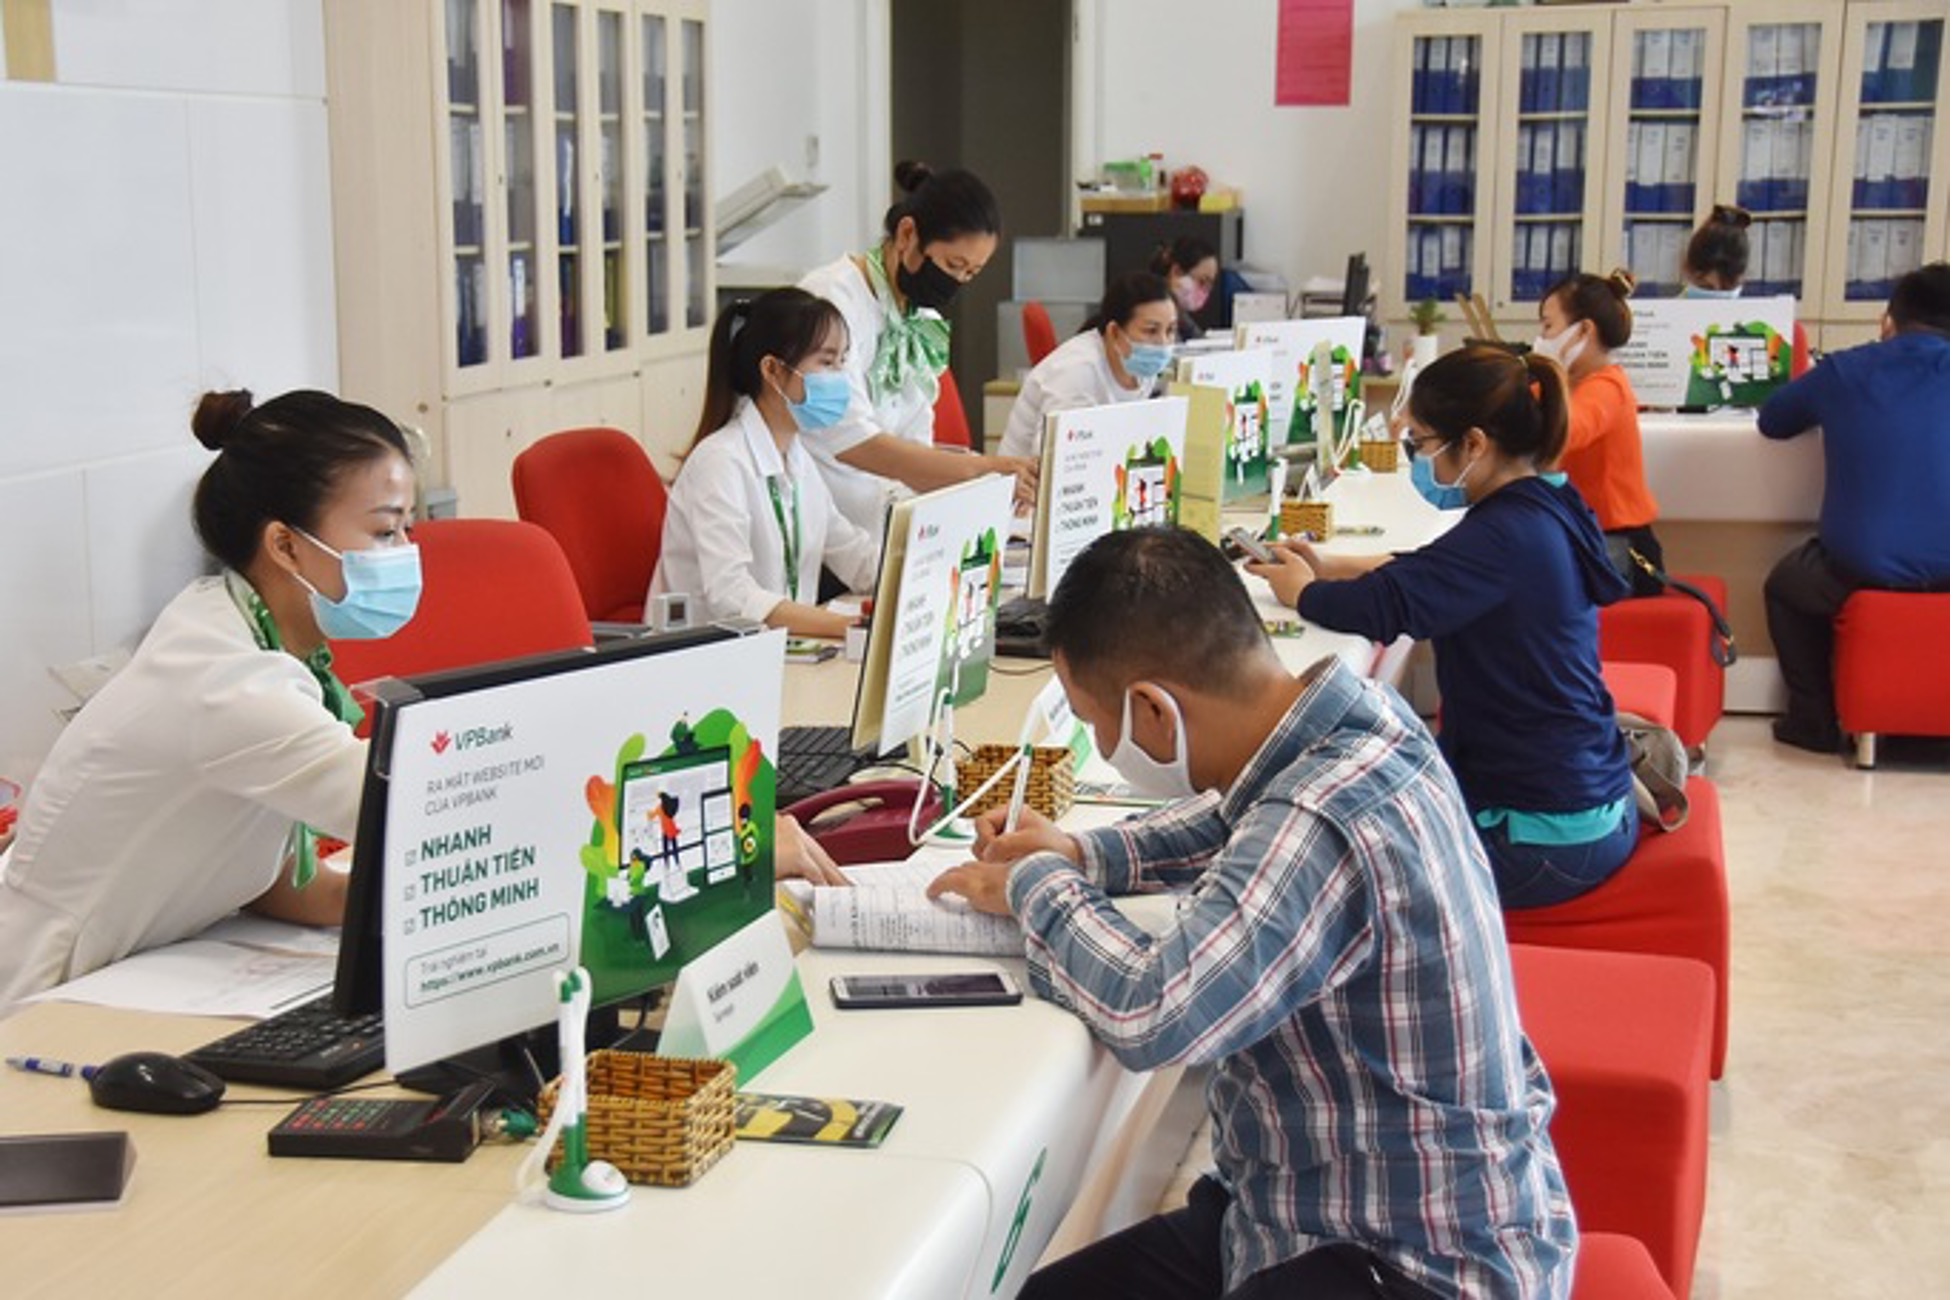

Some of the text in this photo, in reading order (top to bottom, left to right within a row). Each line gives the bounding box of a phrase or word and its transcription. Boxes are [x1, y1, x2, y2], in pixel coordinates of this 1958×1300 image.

[455, 722, 514, 751] VPBank
[472, 758, 521, 785] WEBSITE
[451, 785, 499, 808] VPBANK
[420, 823, 492, 861] NHANH
[419, 878, 540, 929] THÔNG MINH
